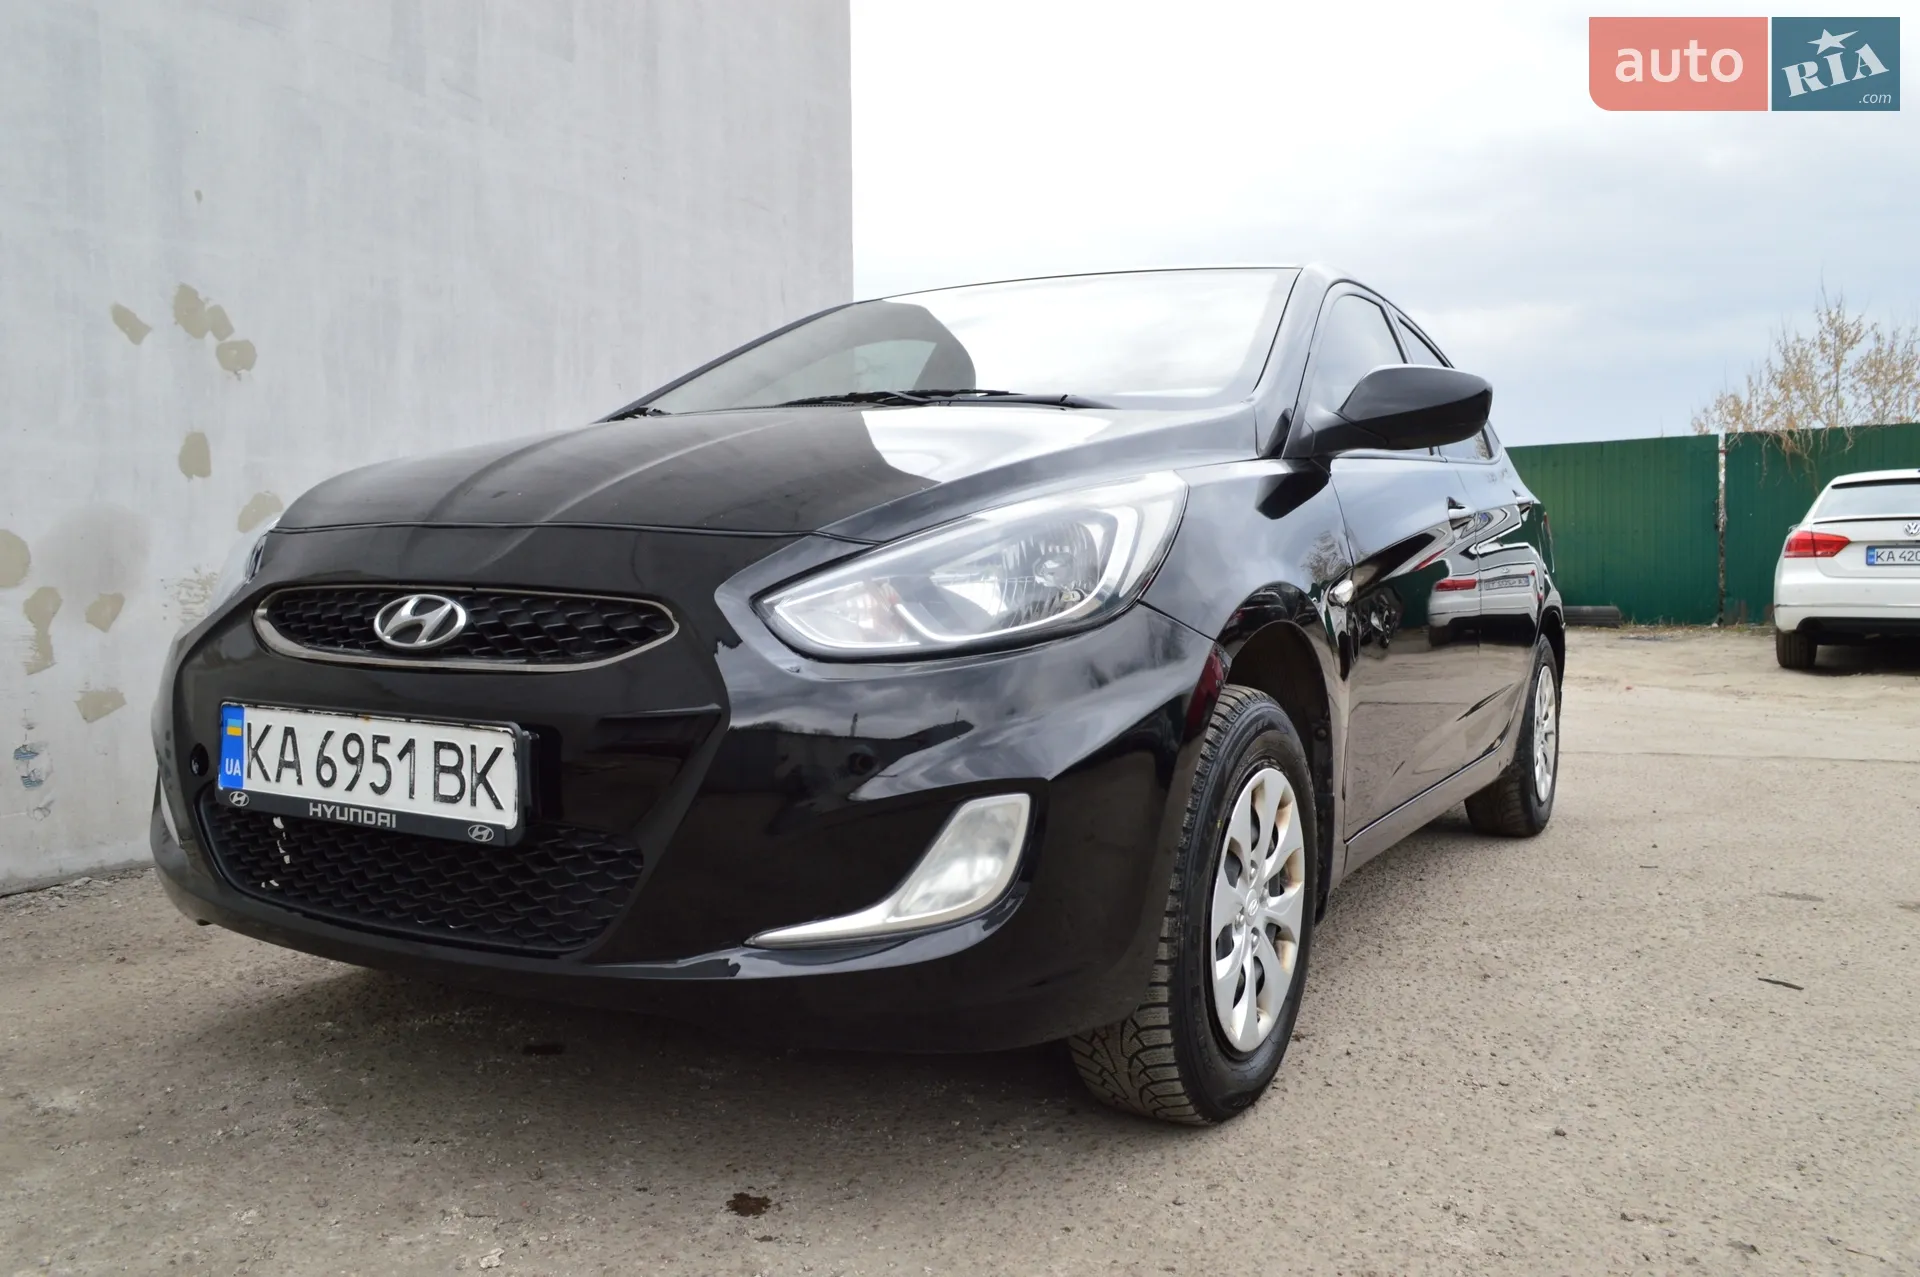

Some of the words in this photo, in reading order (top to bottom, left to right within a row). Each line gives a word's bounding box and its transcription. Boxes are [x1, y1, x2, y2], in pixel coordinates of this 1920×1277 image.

[1875, 550, 1896, 562] KA
[225, 757, 242, 777] UA
[246, 722, 303, 786] KA
[315, 730, 417, 800] 6951
[433, 740, 505, 811] BK
[308, 802, 397, 829] HYUNDAI
